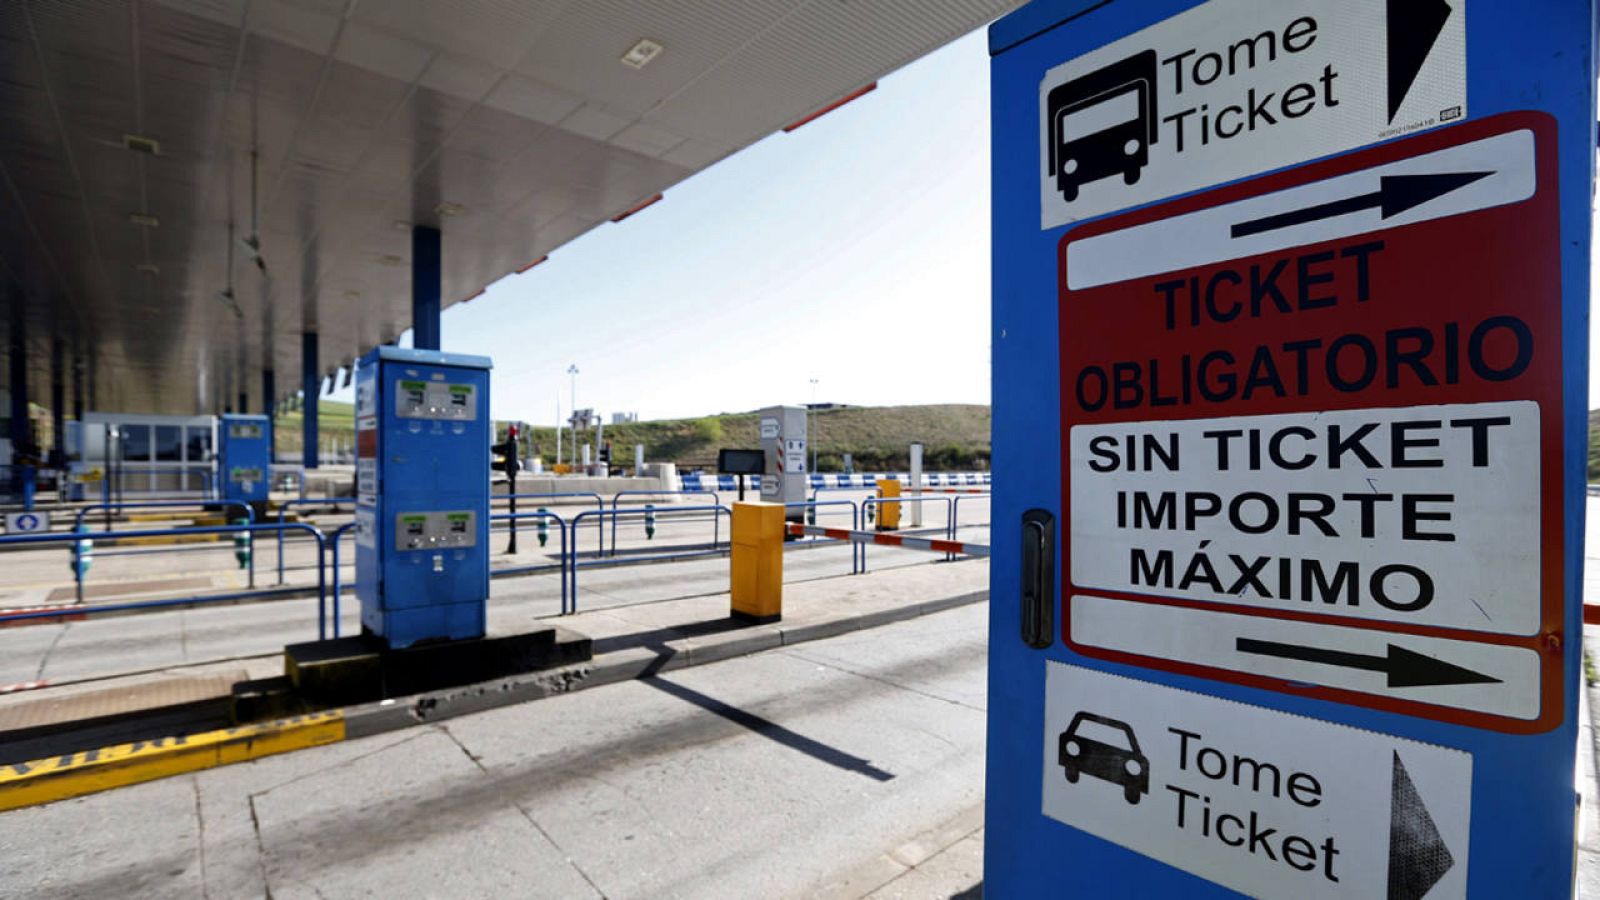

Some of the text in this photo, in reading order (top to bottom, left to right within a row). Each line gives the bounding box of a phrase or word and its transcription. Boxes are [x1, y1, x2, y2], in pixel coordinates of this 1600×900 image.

[1162, 16, 1318, 95] Tome
[1162, 63, 1341, 153] Ticket
[1153, 241, 1386, 331] TICKET
[1074, 315, 1535, 413] OBLIGATORIO
[1087, 415, 1512, 473] SIN TICKET
[1116, 490, 1456, 543] IMPORTE
[1129, 539, 1435, 613] MÁXIMO
[1167, 726, 1323, 808] Tome
[1165, 784, 1341, 884] Ticket
